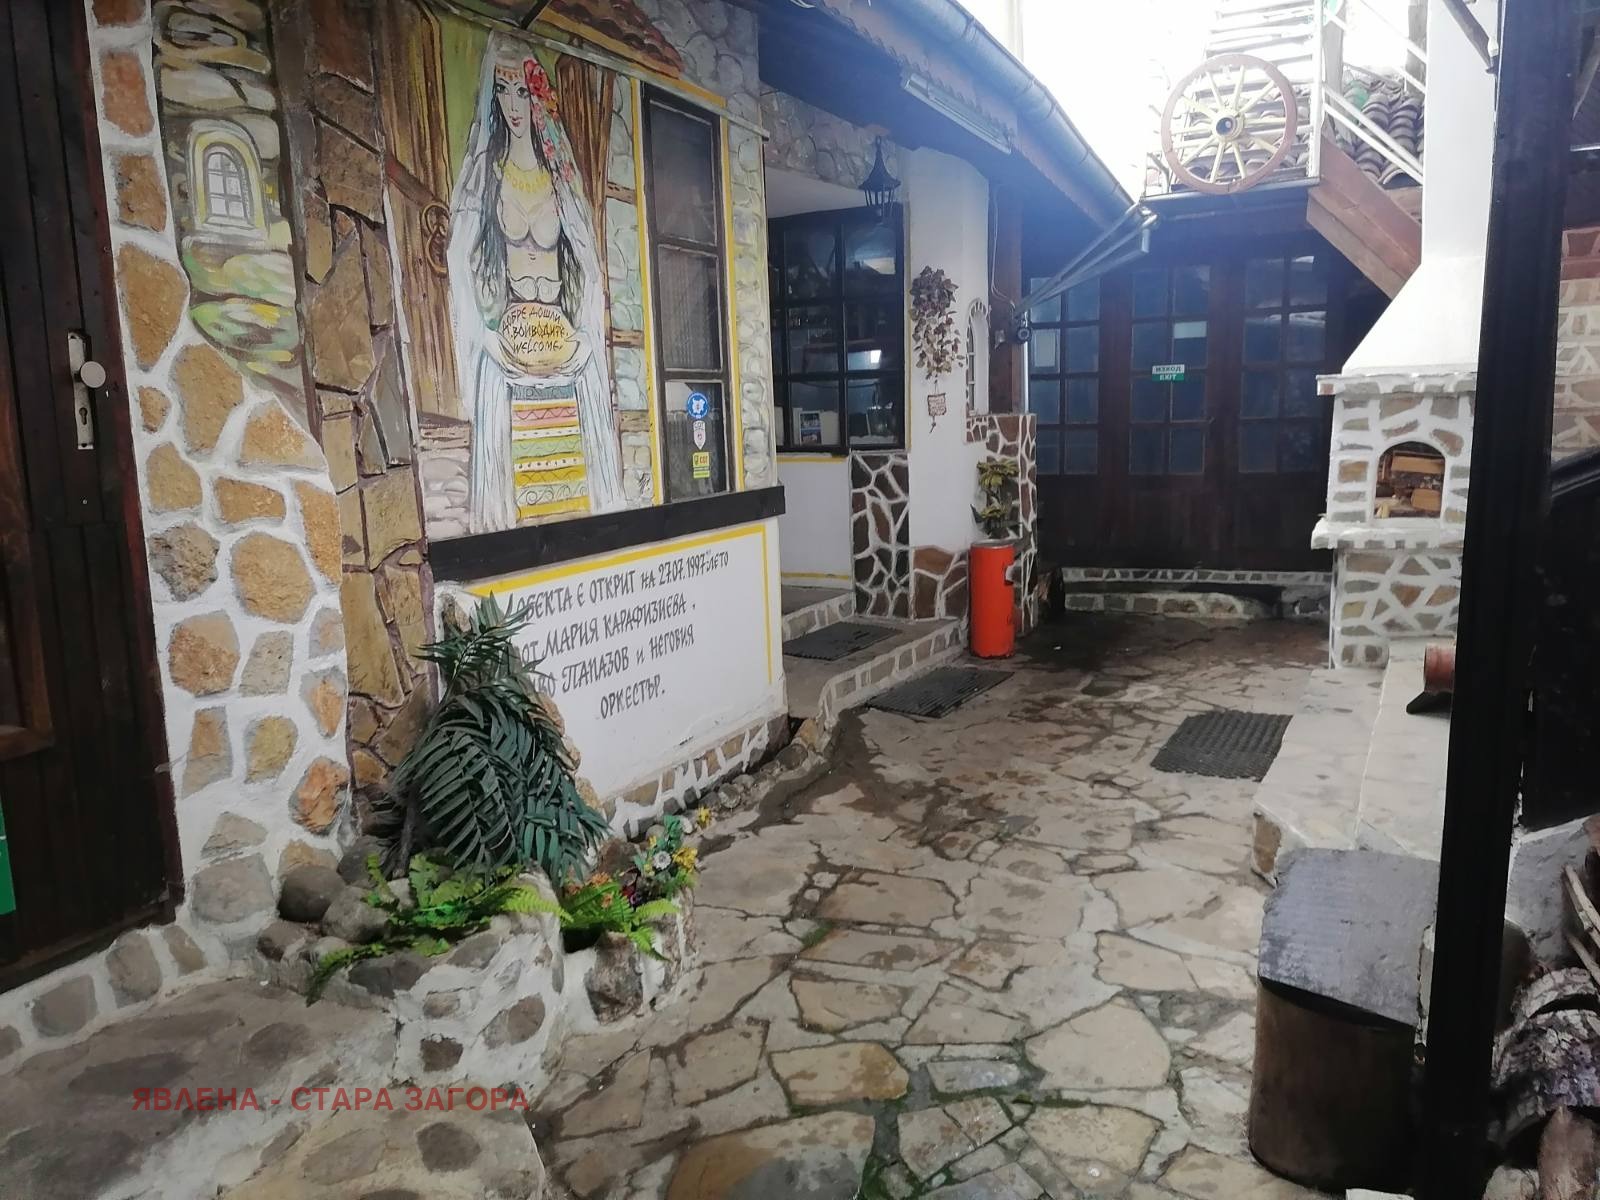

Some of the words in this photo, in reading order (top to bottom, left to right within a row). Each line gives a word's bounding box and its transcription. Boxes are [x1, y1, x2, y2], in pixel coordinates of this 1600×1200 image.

[529, 307, 561, 324] ДОШЛИ
[589, 570, 636, 604] ОТКРИТ
[641, 570, 656, 590] НА
[540, 617, 600, 661] МАРИЯ
[562, 646, 629, 693] ПАПАЗОВ
[649, 623, 694, 661] НЕГОВИЯ
